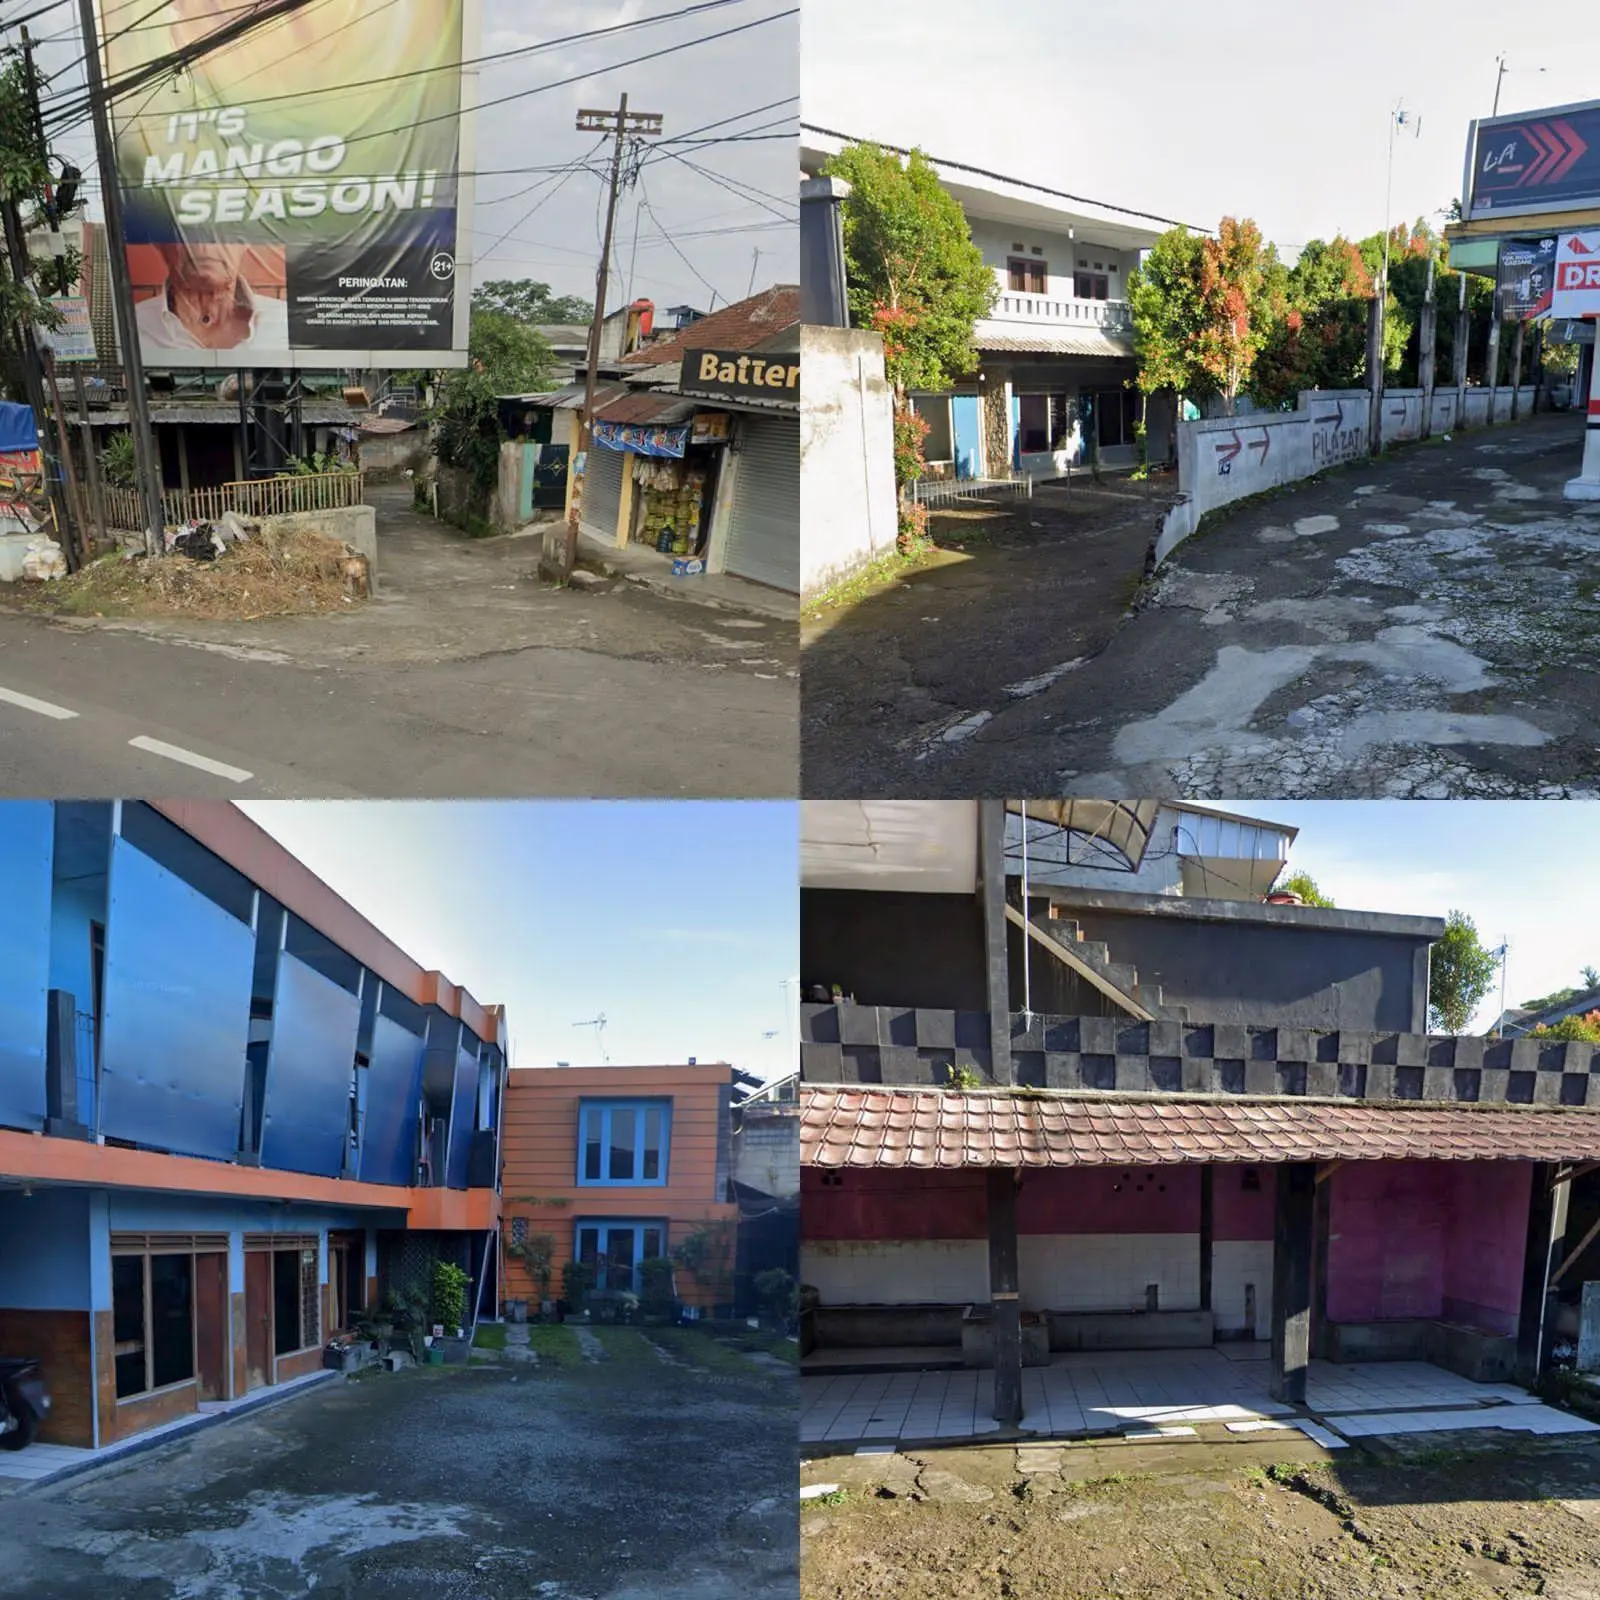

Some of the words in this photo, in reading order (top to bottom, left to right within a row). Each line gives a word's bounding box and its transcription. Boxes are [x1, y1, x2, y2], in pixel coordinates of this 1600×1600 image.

[143, 135, 347, 188] MANGO
[178, 169, 438, 224] SEASON!
[434, 260, 453, 272] 21+
[338, 277, 408, 288] PERINGATAN:
